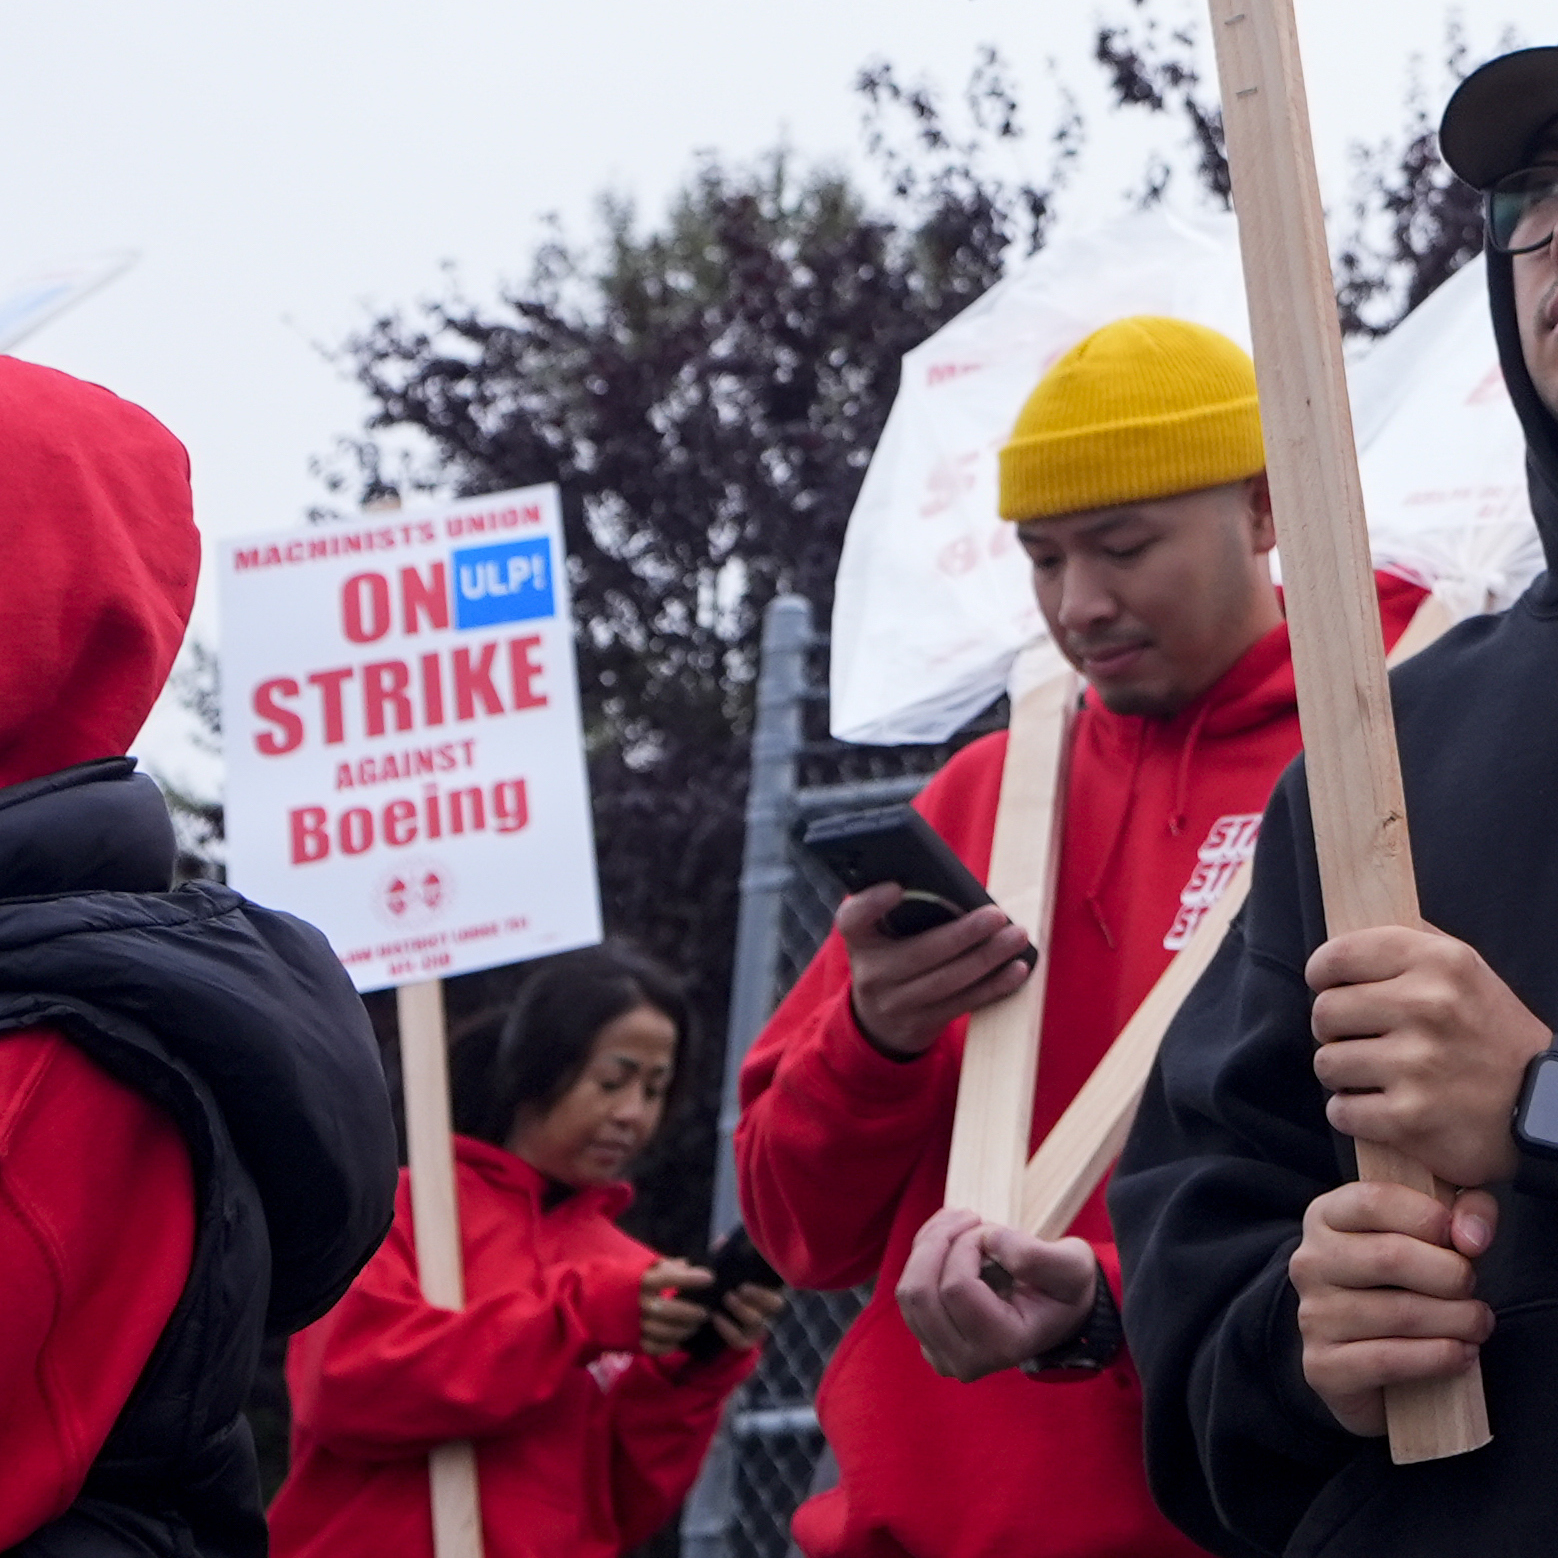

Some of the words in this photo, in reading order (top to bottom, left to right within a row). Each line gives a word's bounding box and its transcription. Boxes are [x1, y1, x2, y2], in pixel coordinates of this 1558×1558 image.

[234, 520, 435, 572] MACHINISTS
[446, 503, 542, 537] UNION
[340, 559, 450, 644] ON
[460, 554, 547, 601] ULP!
[251, 635, 550, 757] STRIKE
[336, 738, 477, 791] AGAINST
[288, 776, 530, 867] Boeing
